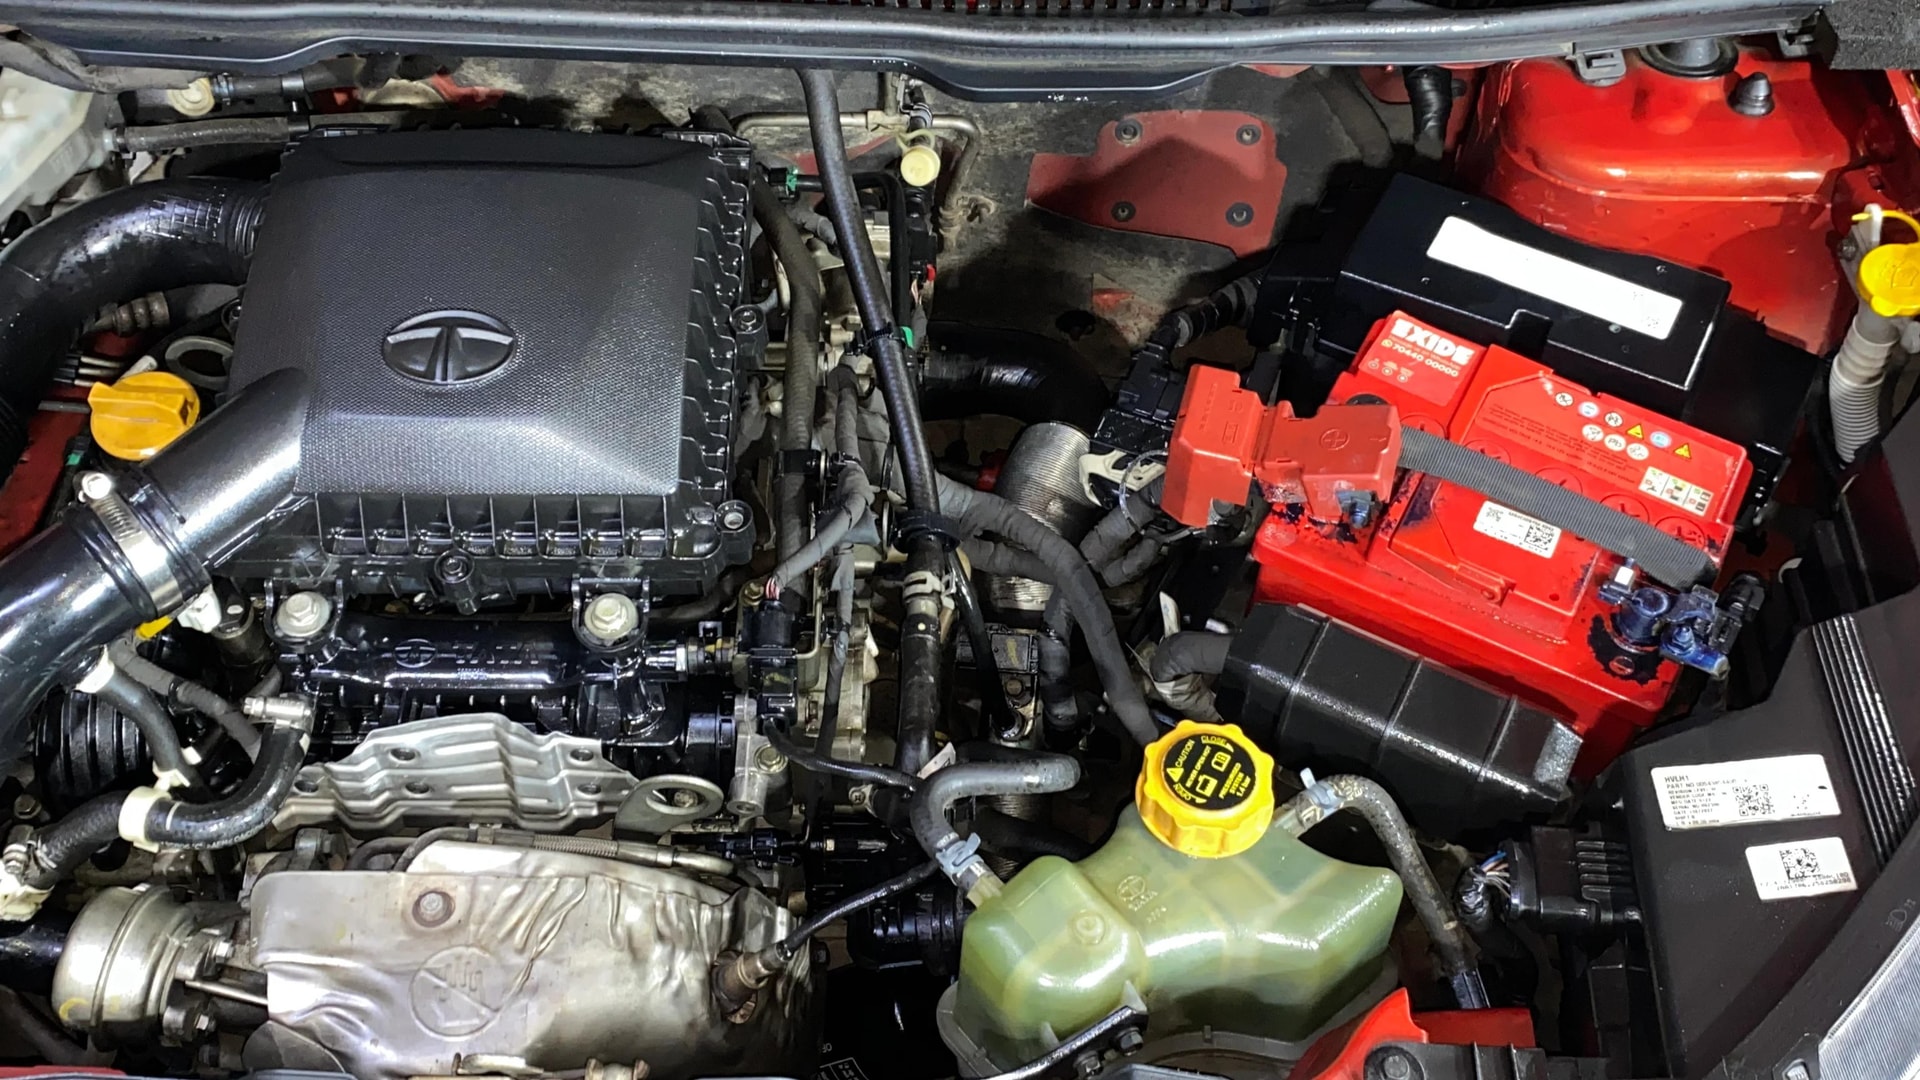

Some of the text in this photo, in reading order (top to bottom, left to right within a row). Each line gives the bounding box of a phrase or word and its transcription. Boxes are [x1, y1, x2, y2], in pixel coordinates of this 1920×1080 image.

[1391, 318, 1475, 366] EXIDE
[1392, 343, 1459, 377] 70440 00000
[1608, 437, 1622, 447] Pb
[1201, 735, 1227, 746] CLOSE
[1175, 739, 1195, 767] CAUTION
[1186, 745, 1212, 788] NEVER OPEN HOT
[1173, 783, 1192, 800] OPEN
[1229, 772, 1244, 794] SYSTEM
[1236, 775, 1251, 797] 1.4 bar
